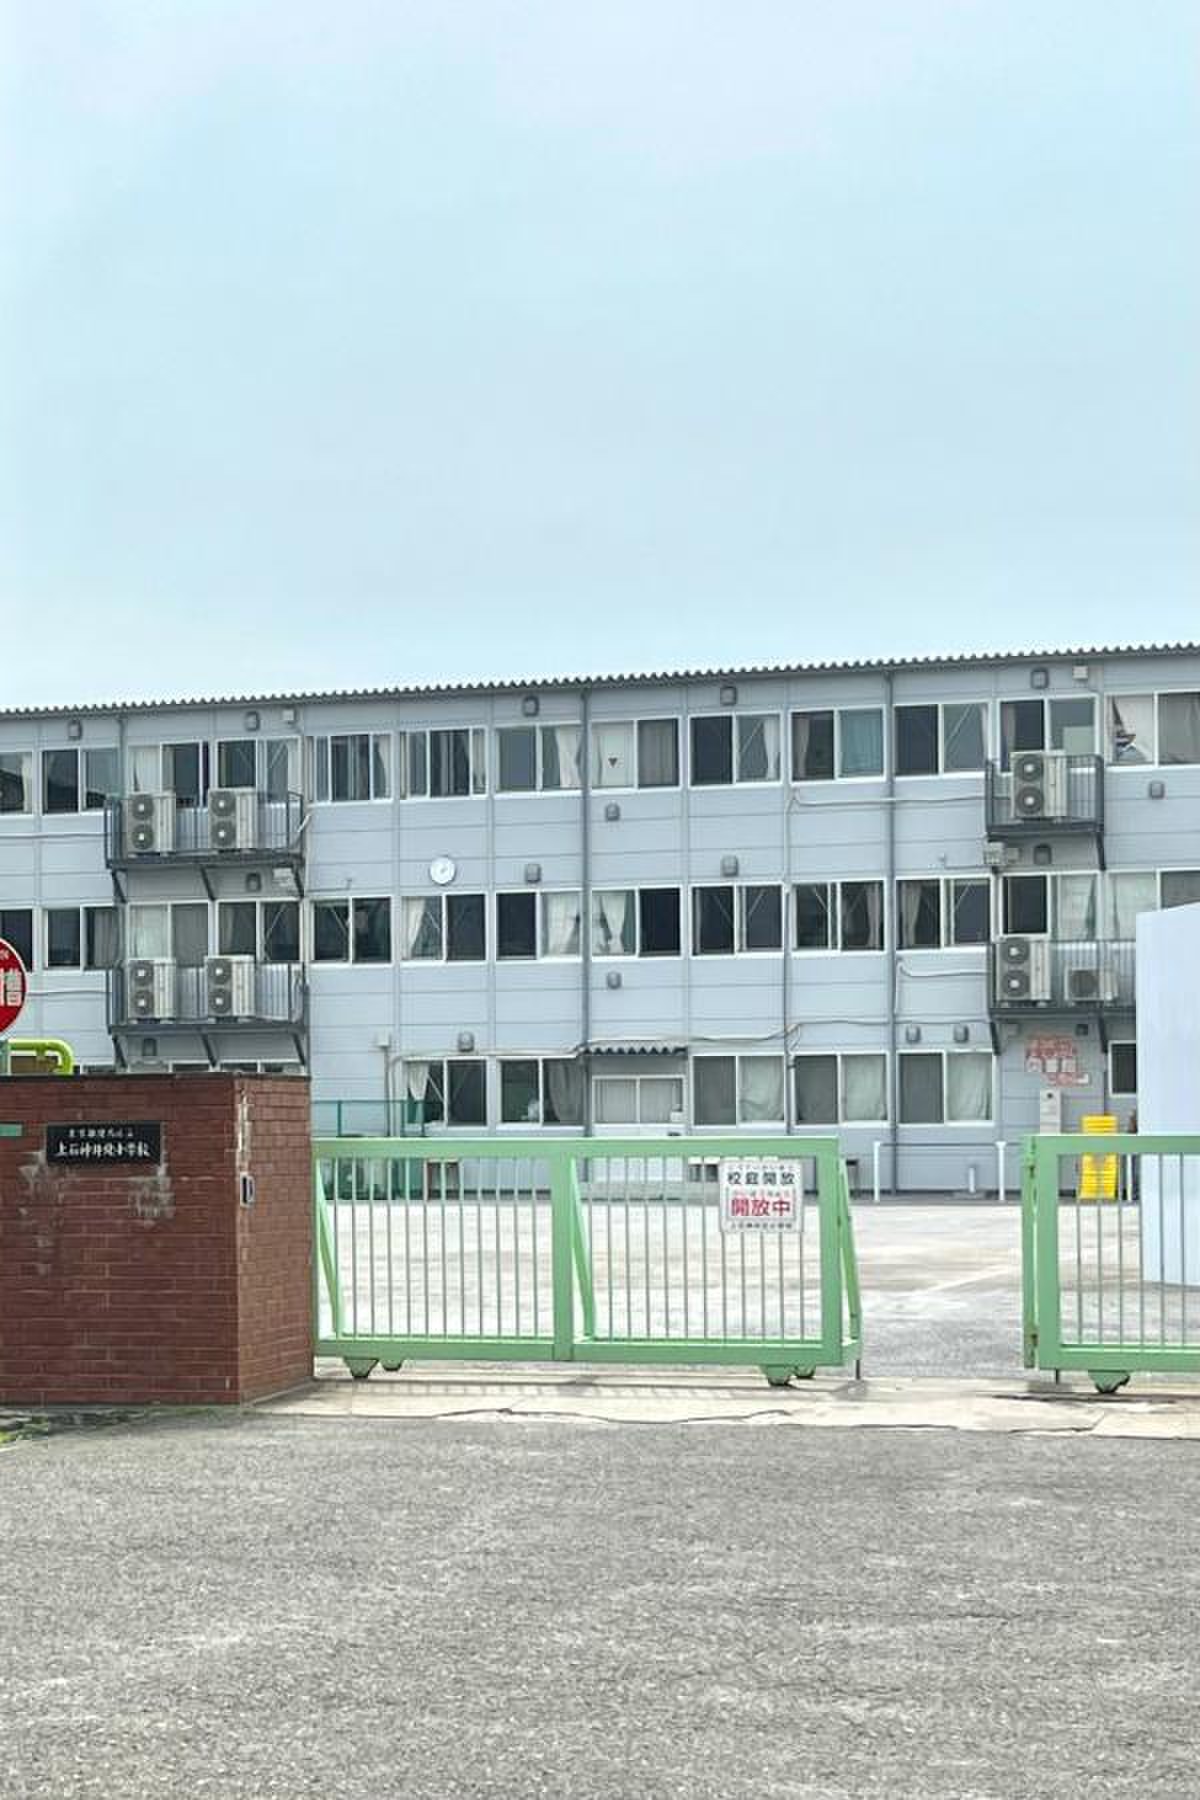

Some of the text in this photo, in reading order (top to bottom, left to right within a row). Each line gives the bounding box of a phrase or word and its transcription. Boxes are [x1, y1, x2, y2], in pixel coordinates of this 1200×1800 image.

[728, 1172, 795, 1185] 校庭開放
[731, 1199, 790, 1217] 開放中
